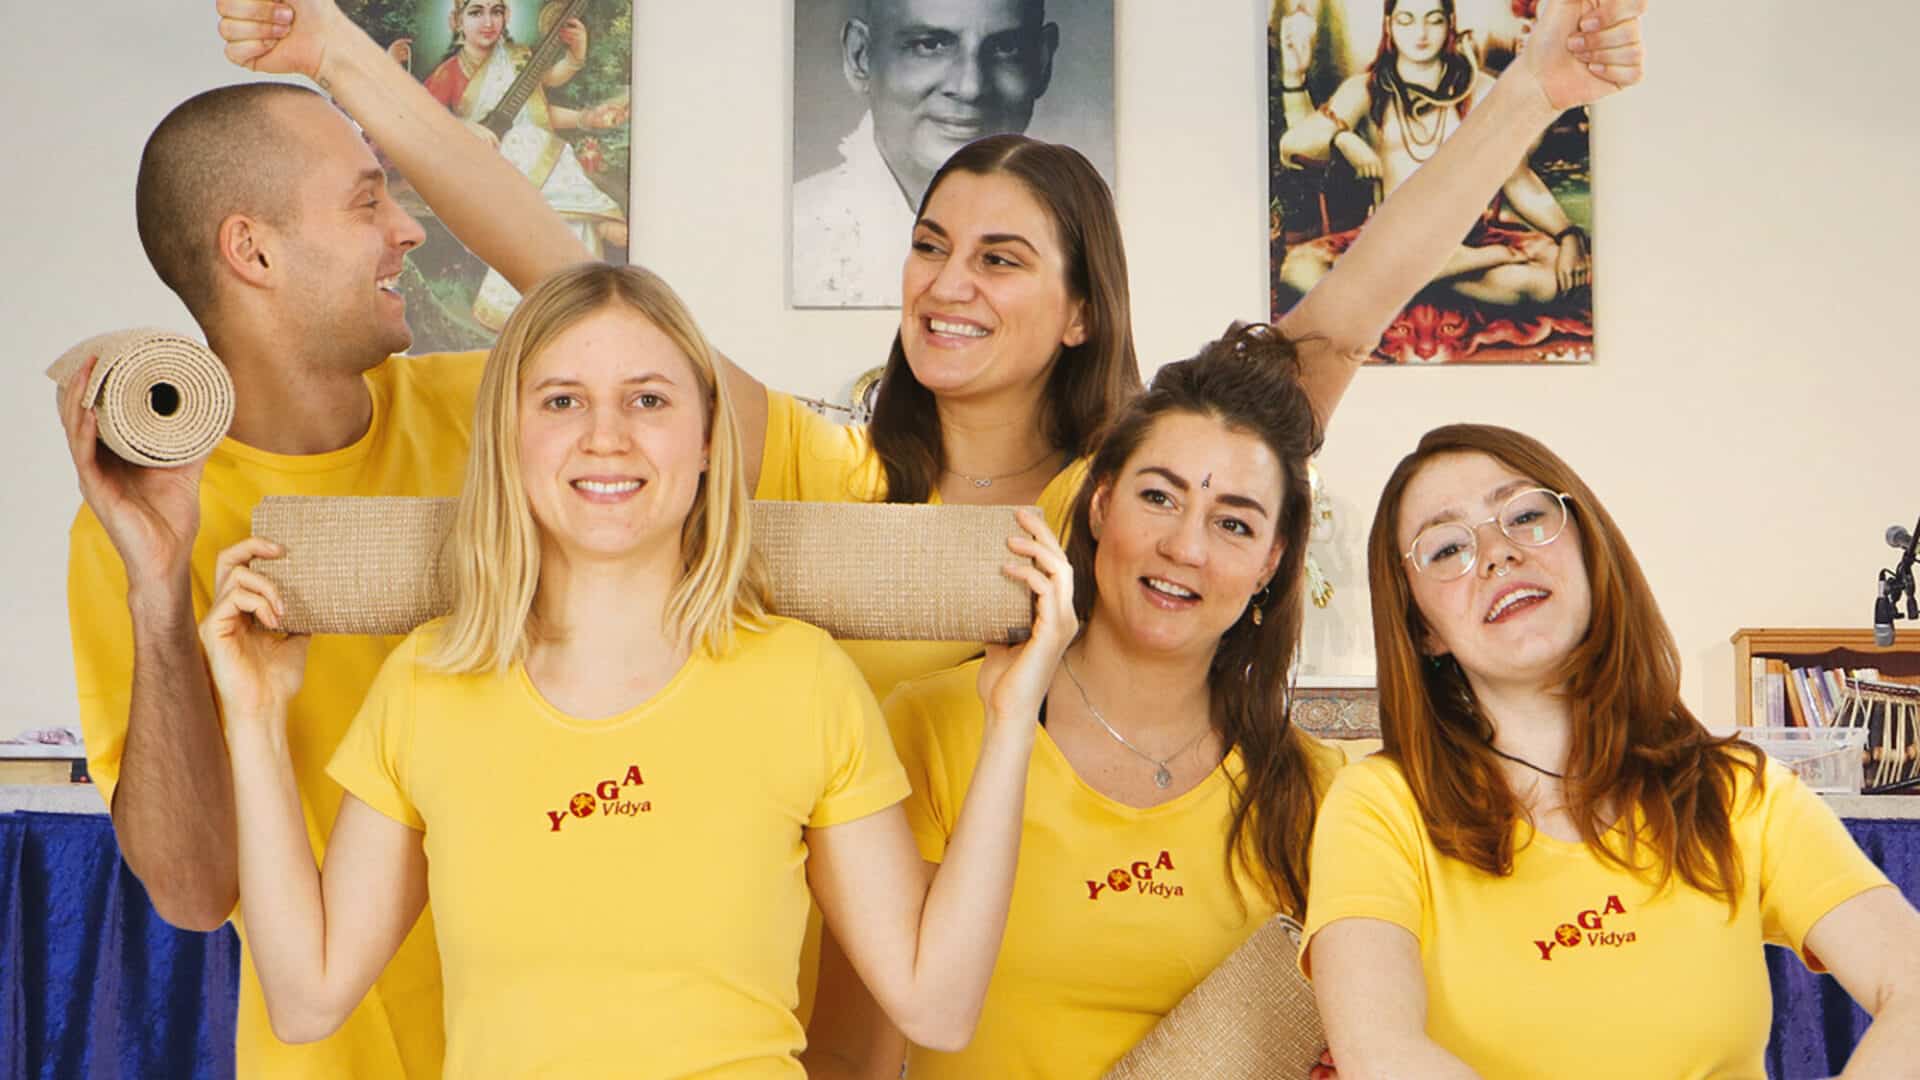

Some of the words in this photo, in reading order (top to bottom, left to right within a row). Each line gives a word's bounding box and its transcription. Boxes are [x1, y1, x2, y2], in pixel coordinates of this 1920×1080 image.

[602, 801, 651, 816] Vidya
[1137, 880, 1184, 899] Vidya
[1587, 931, 1636, 947] Vidya
